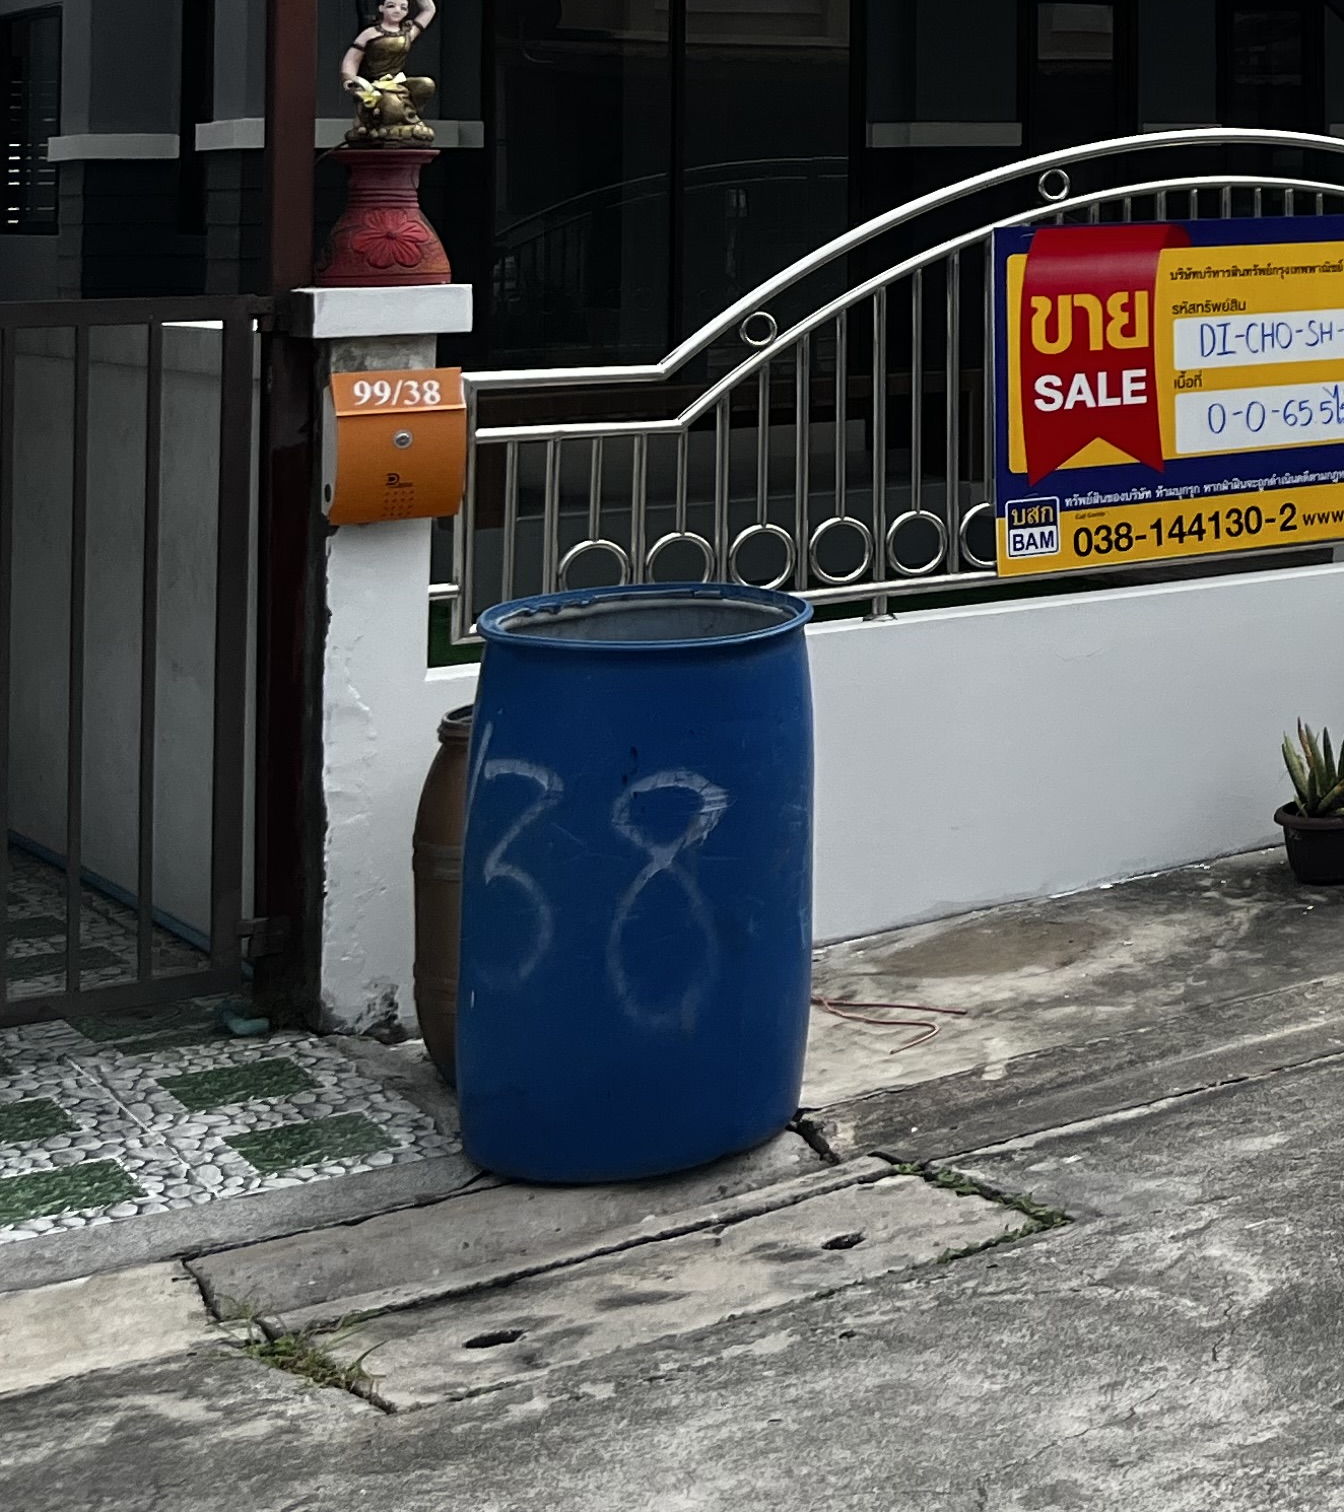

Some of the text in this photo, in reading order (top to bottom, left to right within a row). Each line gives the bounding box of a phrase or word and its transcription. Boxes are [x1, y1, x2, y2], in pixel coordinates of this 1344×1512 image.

[1171, 298, 1247, 315] รหัสทรัพย์สิน
[1030, 290, 1150, 355] ขาย
[353, 379, 441, 406] 99/38
[1033, 368, 1148, 412] SALE
[1011, 504, 1055, 527] บสก
[1012, 529, 1055, 552] BAM
[1072, 503, 1298, 558] 038-144130-2
